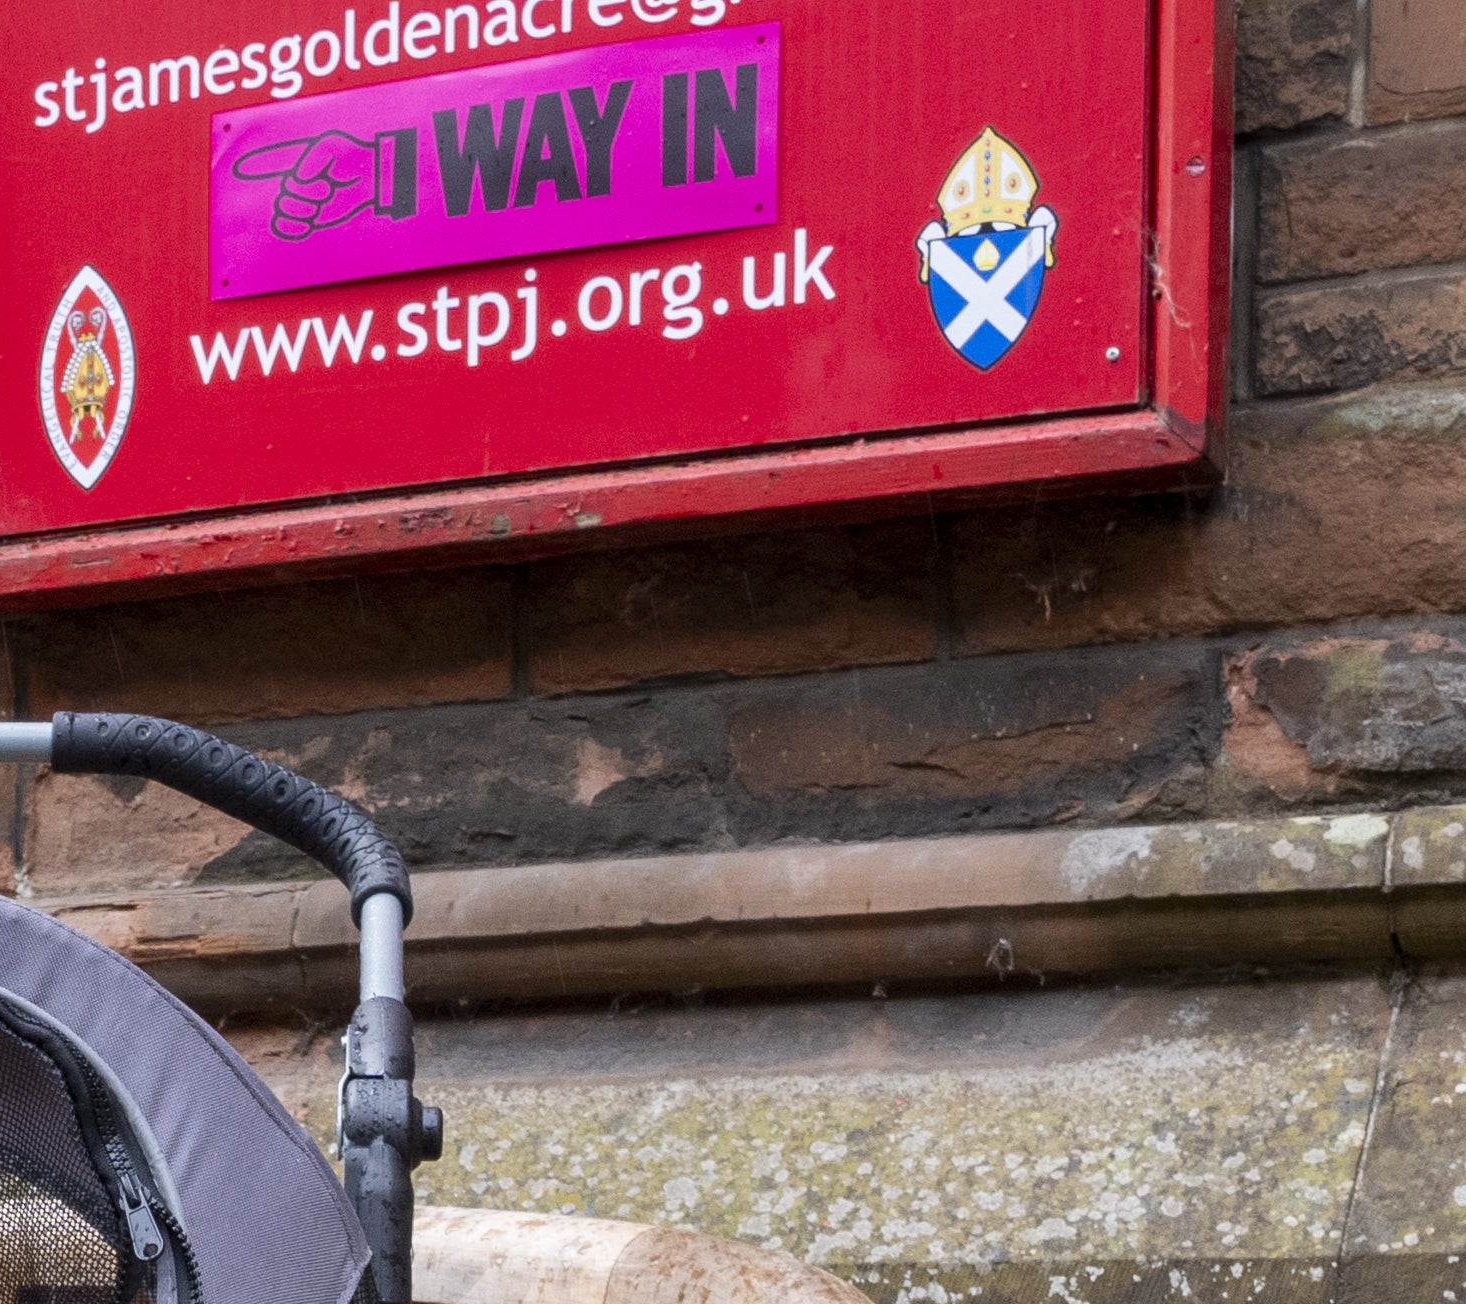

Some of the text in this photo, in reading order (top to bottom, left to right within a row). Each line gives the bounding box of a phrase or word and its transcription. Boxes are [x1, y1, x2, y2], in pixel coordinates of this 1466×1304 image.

[432, 64, 759, 218] WAY IN
[189, 228, 835, 385] www.stpj.org.uk
